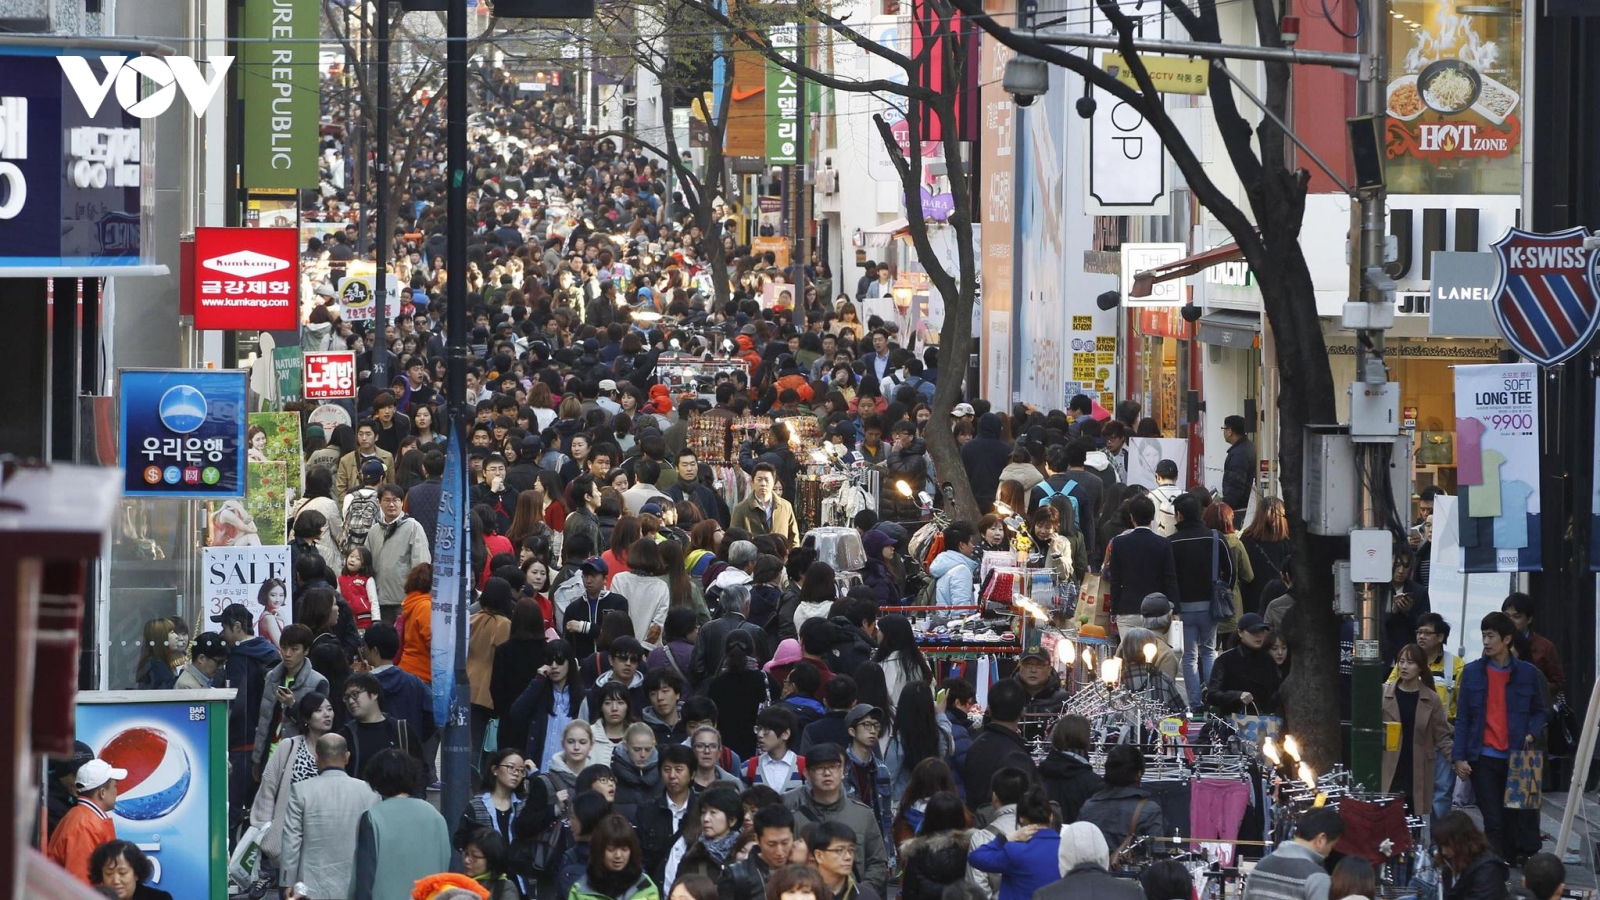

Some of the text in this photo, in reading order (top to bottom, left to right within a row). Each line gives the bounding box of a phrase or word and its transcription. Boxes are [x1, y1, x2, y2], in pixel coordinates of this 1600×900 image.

[1148, 71, 1174, 80] CCTV
[271, 50, 293, 170] REPUBLIC
[1111, 101, 1143, 160] OP
[1419, 124, 1507, 152] HOT ZONE
[922, 200, 948, 210] BARA
[201, 281, 291, 295] 금강제화
[1153, 284, 1175, 296] OP
[201, 298, 289, 308] www.kumkang.com
[306, 361, 353, 389] 노래방
[1504, 379, 1531, 391] SOFT
[1475, 391, 1532, 405] LONG TEE
[141, 437, 224, 462] 우리은행
[210, 553, 285, 561] SPRING
[210, 561, 287, 585] SALE
[190, 706, 205, 714] BAR
